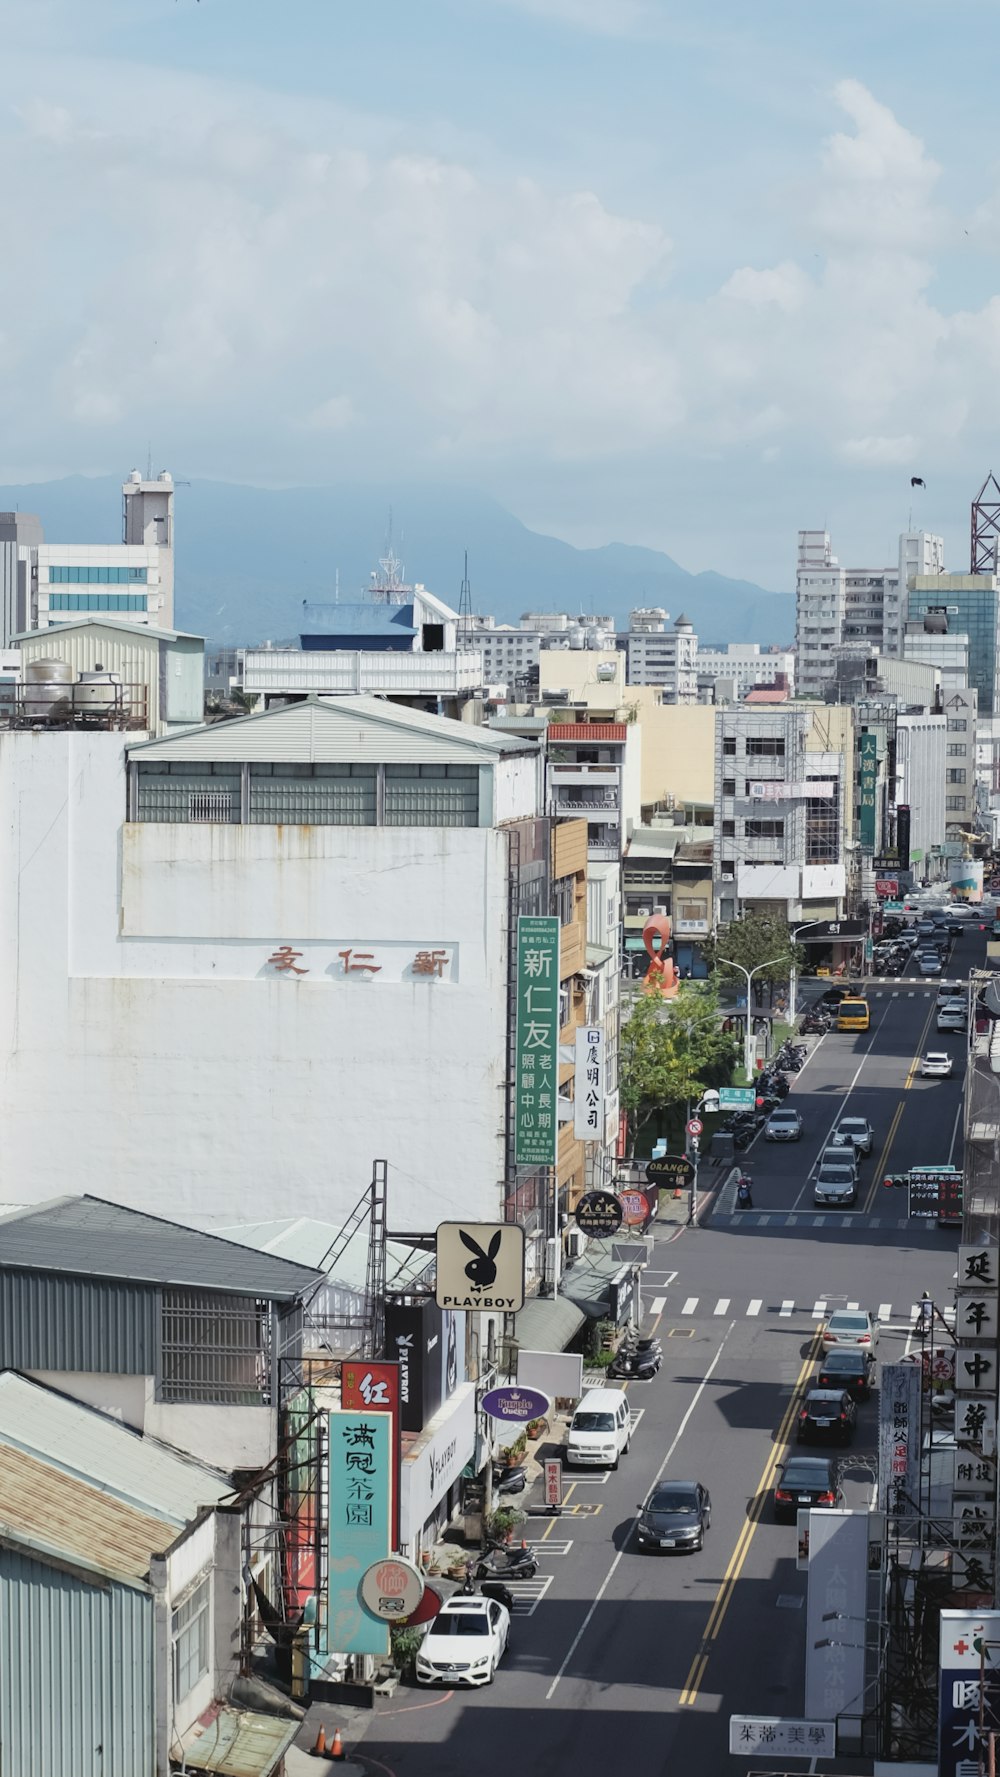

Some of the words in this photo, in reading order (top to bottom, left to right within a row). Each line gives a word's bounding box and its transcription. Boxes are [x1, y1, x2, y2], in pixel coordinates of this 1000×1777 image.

[862, 741, 875, 807] 大漢書局
[523, 948, 553, 1049] 新仁友
[521, 1054, 535, 1128] 照顧中心
[538, 1054, 552, 1128] 老人長期
[586, 1045, 600, 1129] 慶明公司
[443, 1296, 515, 1308] PLAYBOY
[399, 1348, 409, 1403] PLAYBOY
[497, 1398, 533, 1410] Purple
[502, 1407, 528, 1417] Queen
[342, 1423, 377, 1526] 滿冠茶園
[435, 1437, 457, 1478] PLAYBOY
